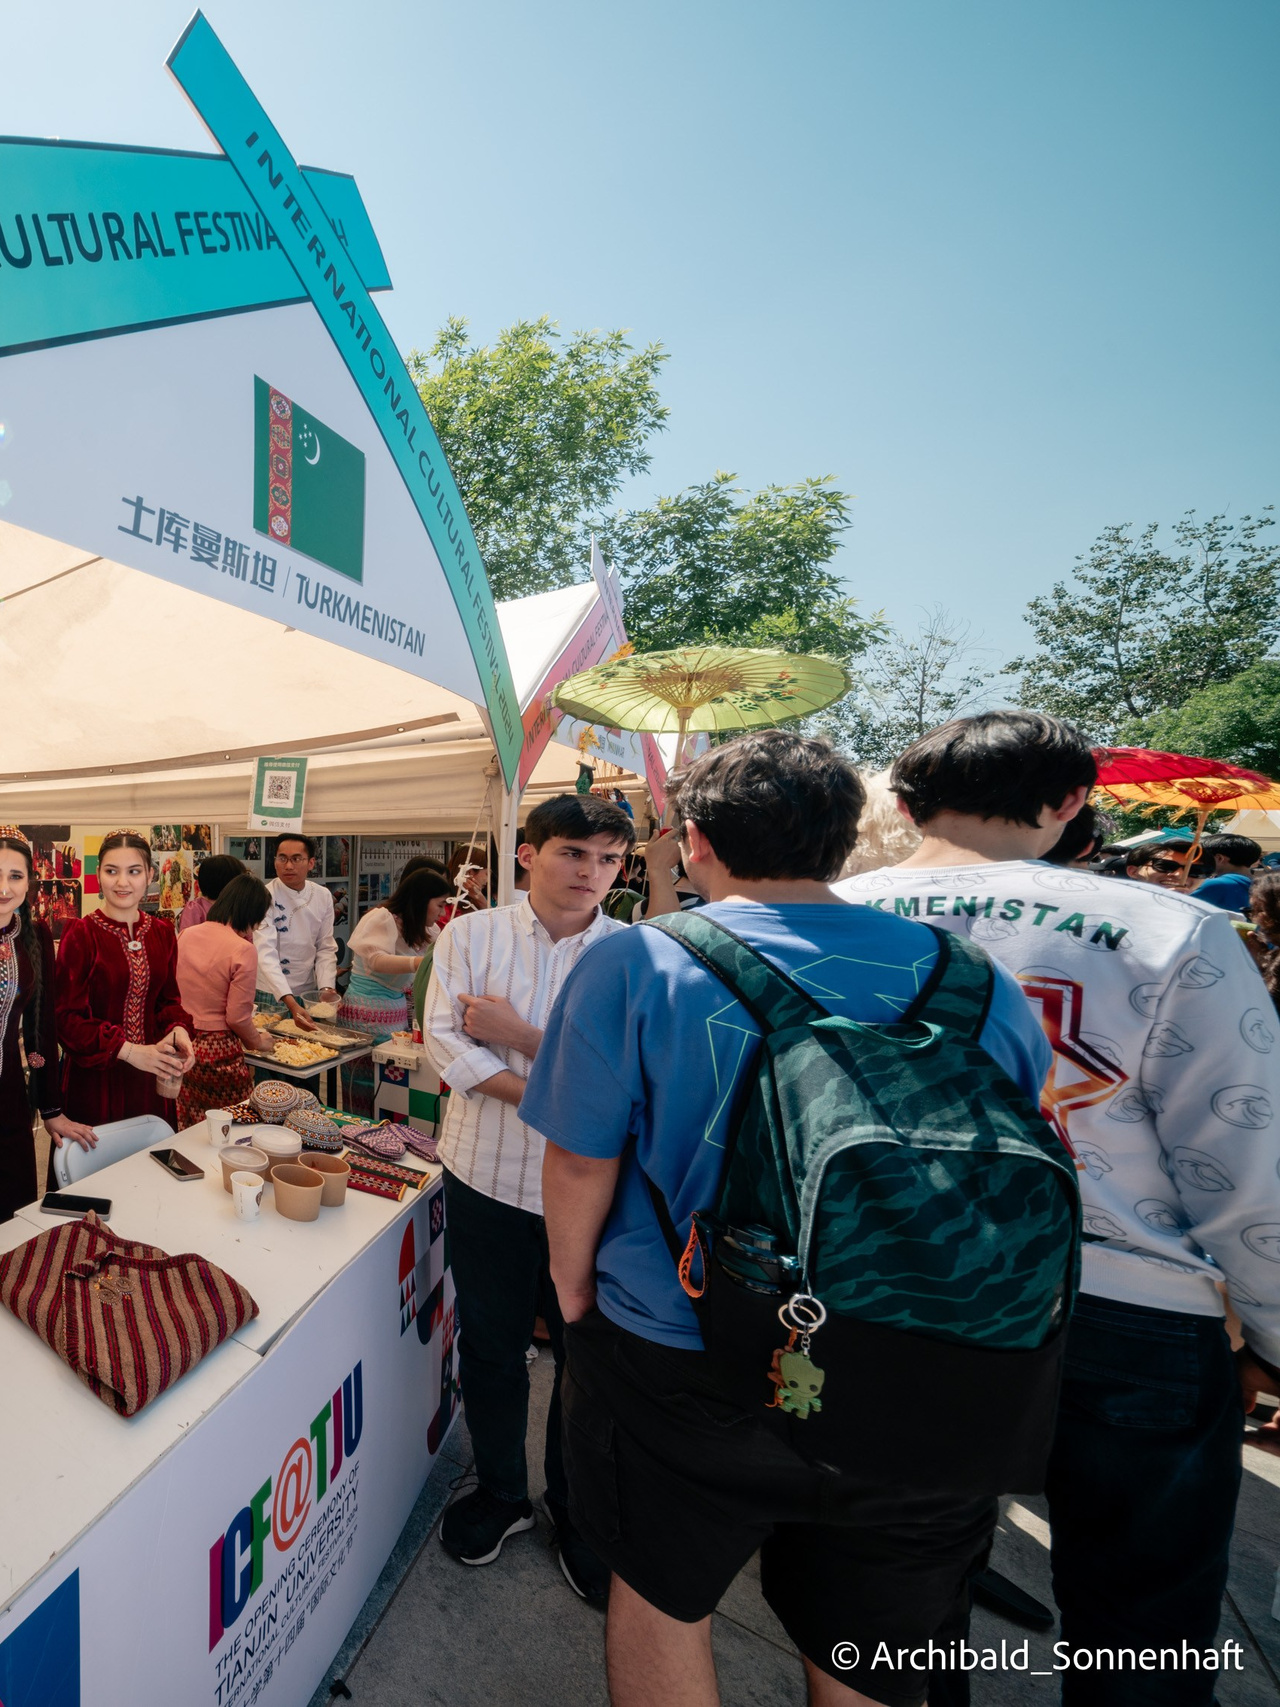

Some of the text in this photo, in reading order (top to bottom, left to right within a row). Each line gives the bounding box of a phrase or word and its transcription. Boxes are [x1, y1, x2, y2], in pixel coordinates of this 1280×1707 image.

[174, 210, 283, 257] FESTIVA
[245, 131, 515, 746] INTERNATIONAL CULTURAL FESTIVAL 2024
[117, 495, 278, 594] 土库曼斯坦
[295, 572, 427, 657] TURKMENISTAN
[865, 896, 1130, 951] KMENISTAN
[209, 1359, 363, 1655] ICF@TJU
[214, 1460, 360, 1679] THE OPENING CEREMONY OF
[281, 1570, 317, 1629] CULTURAL
[317, 1529, 345, 1573] FESTIVAL
[345, 1503, 359, 1529] 2024
[214, 1480, 360, 1706] TIANJIN UNIVERSITY
